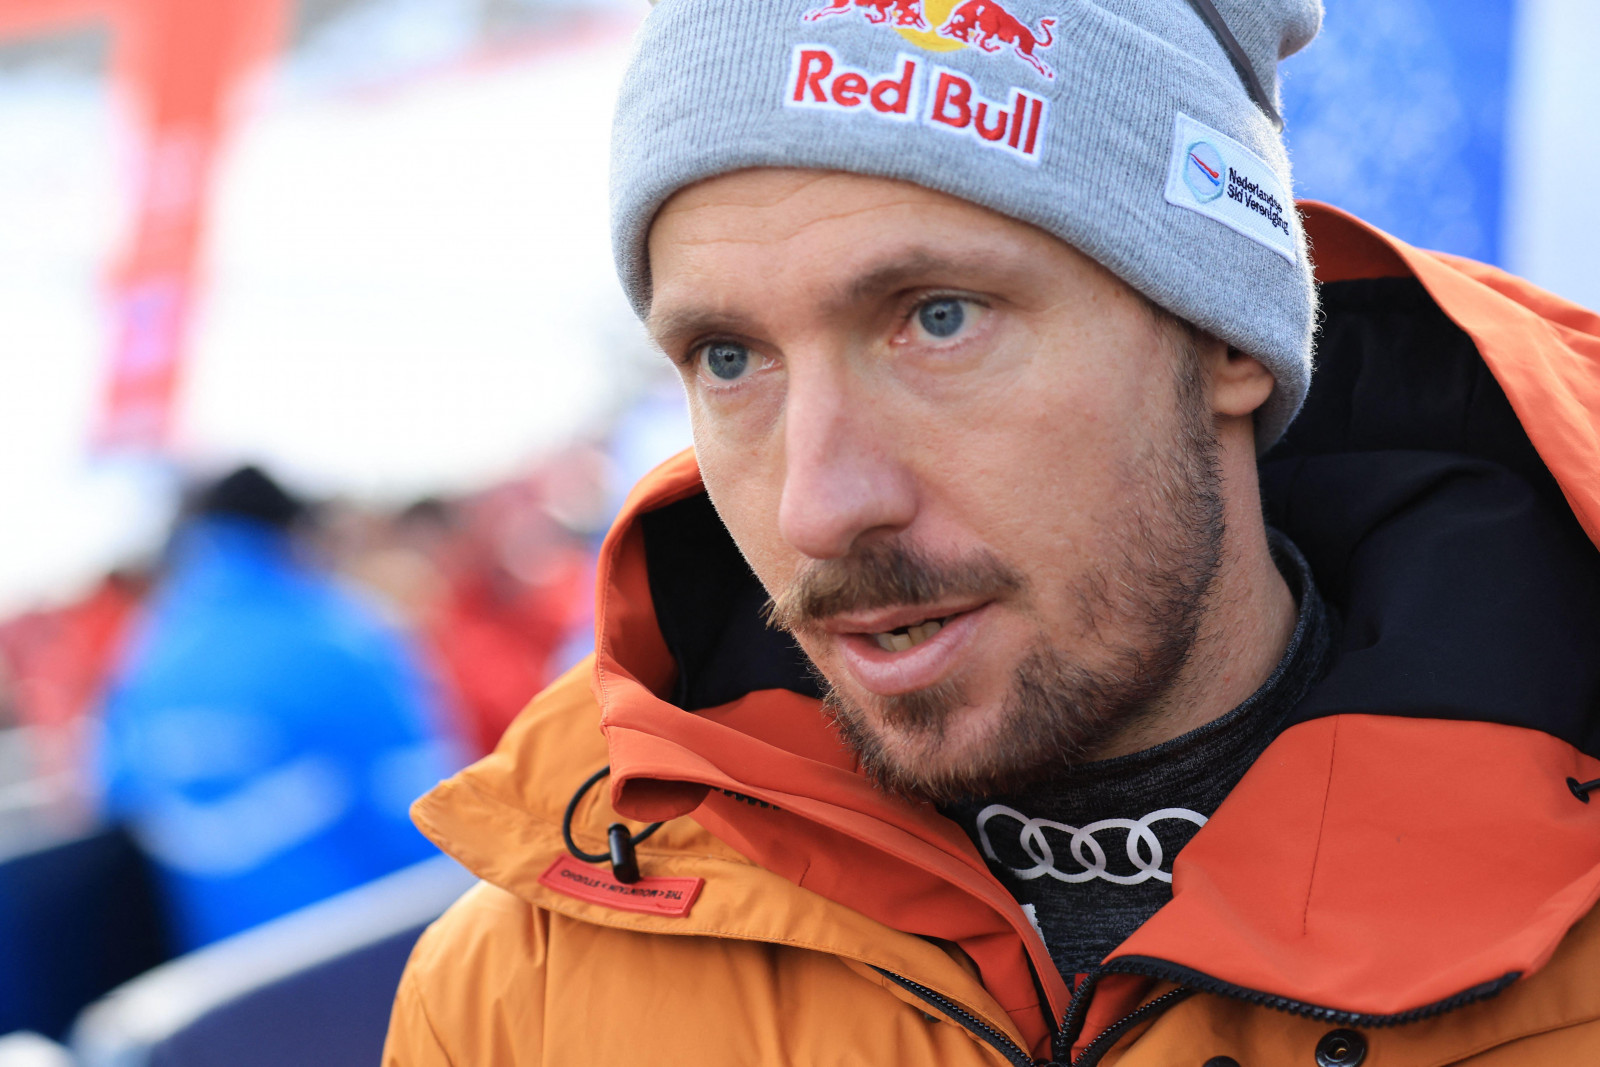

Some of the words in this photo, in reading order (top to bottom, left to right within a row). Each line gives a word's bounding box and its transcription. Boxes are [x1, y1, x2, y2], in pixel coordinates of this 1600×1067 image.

[793, 50, 916, 114] Red
[931, 73, 1043, 154] Bull
[1227, 185, 1244, 204] Ski
[1229, 167, 1283, 213] Nederlandse
[664, 891, 683, 900] THE
